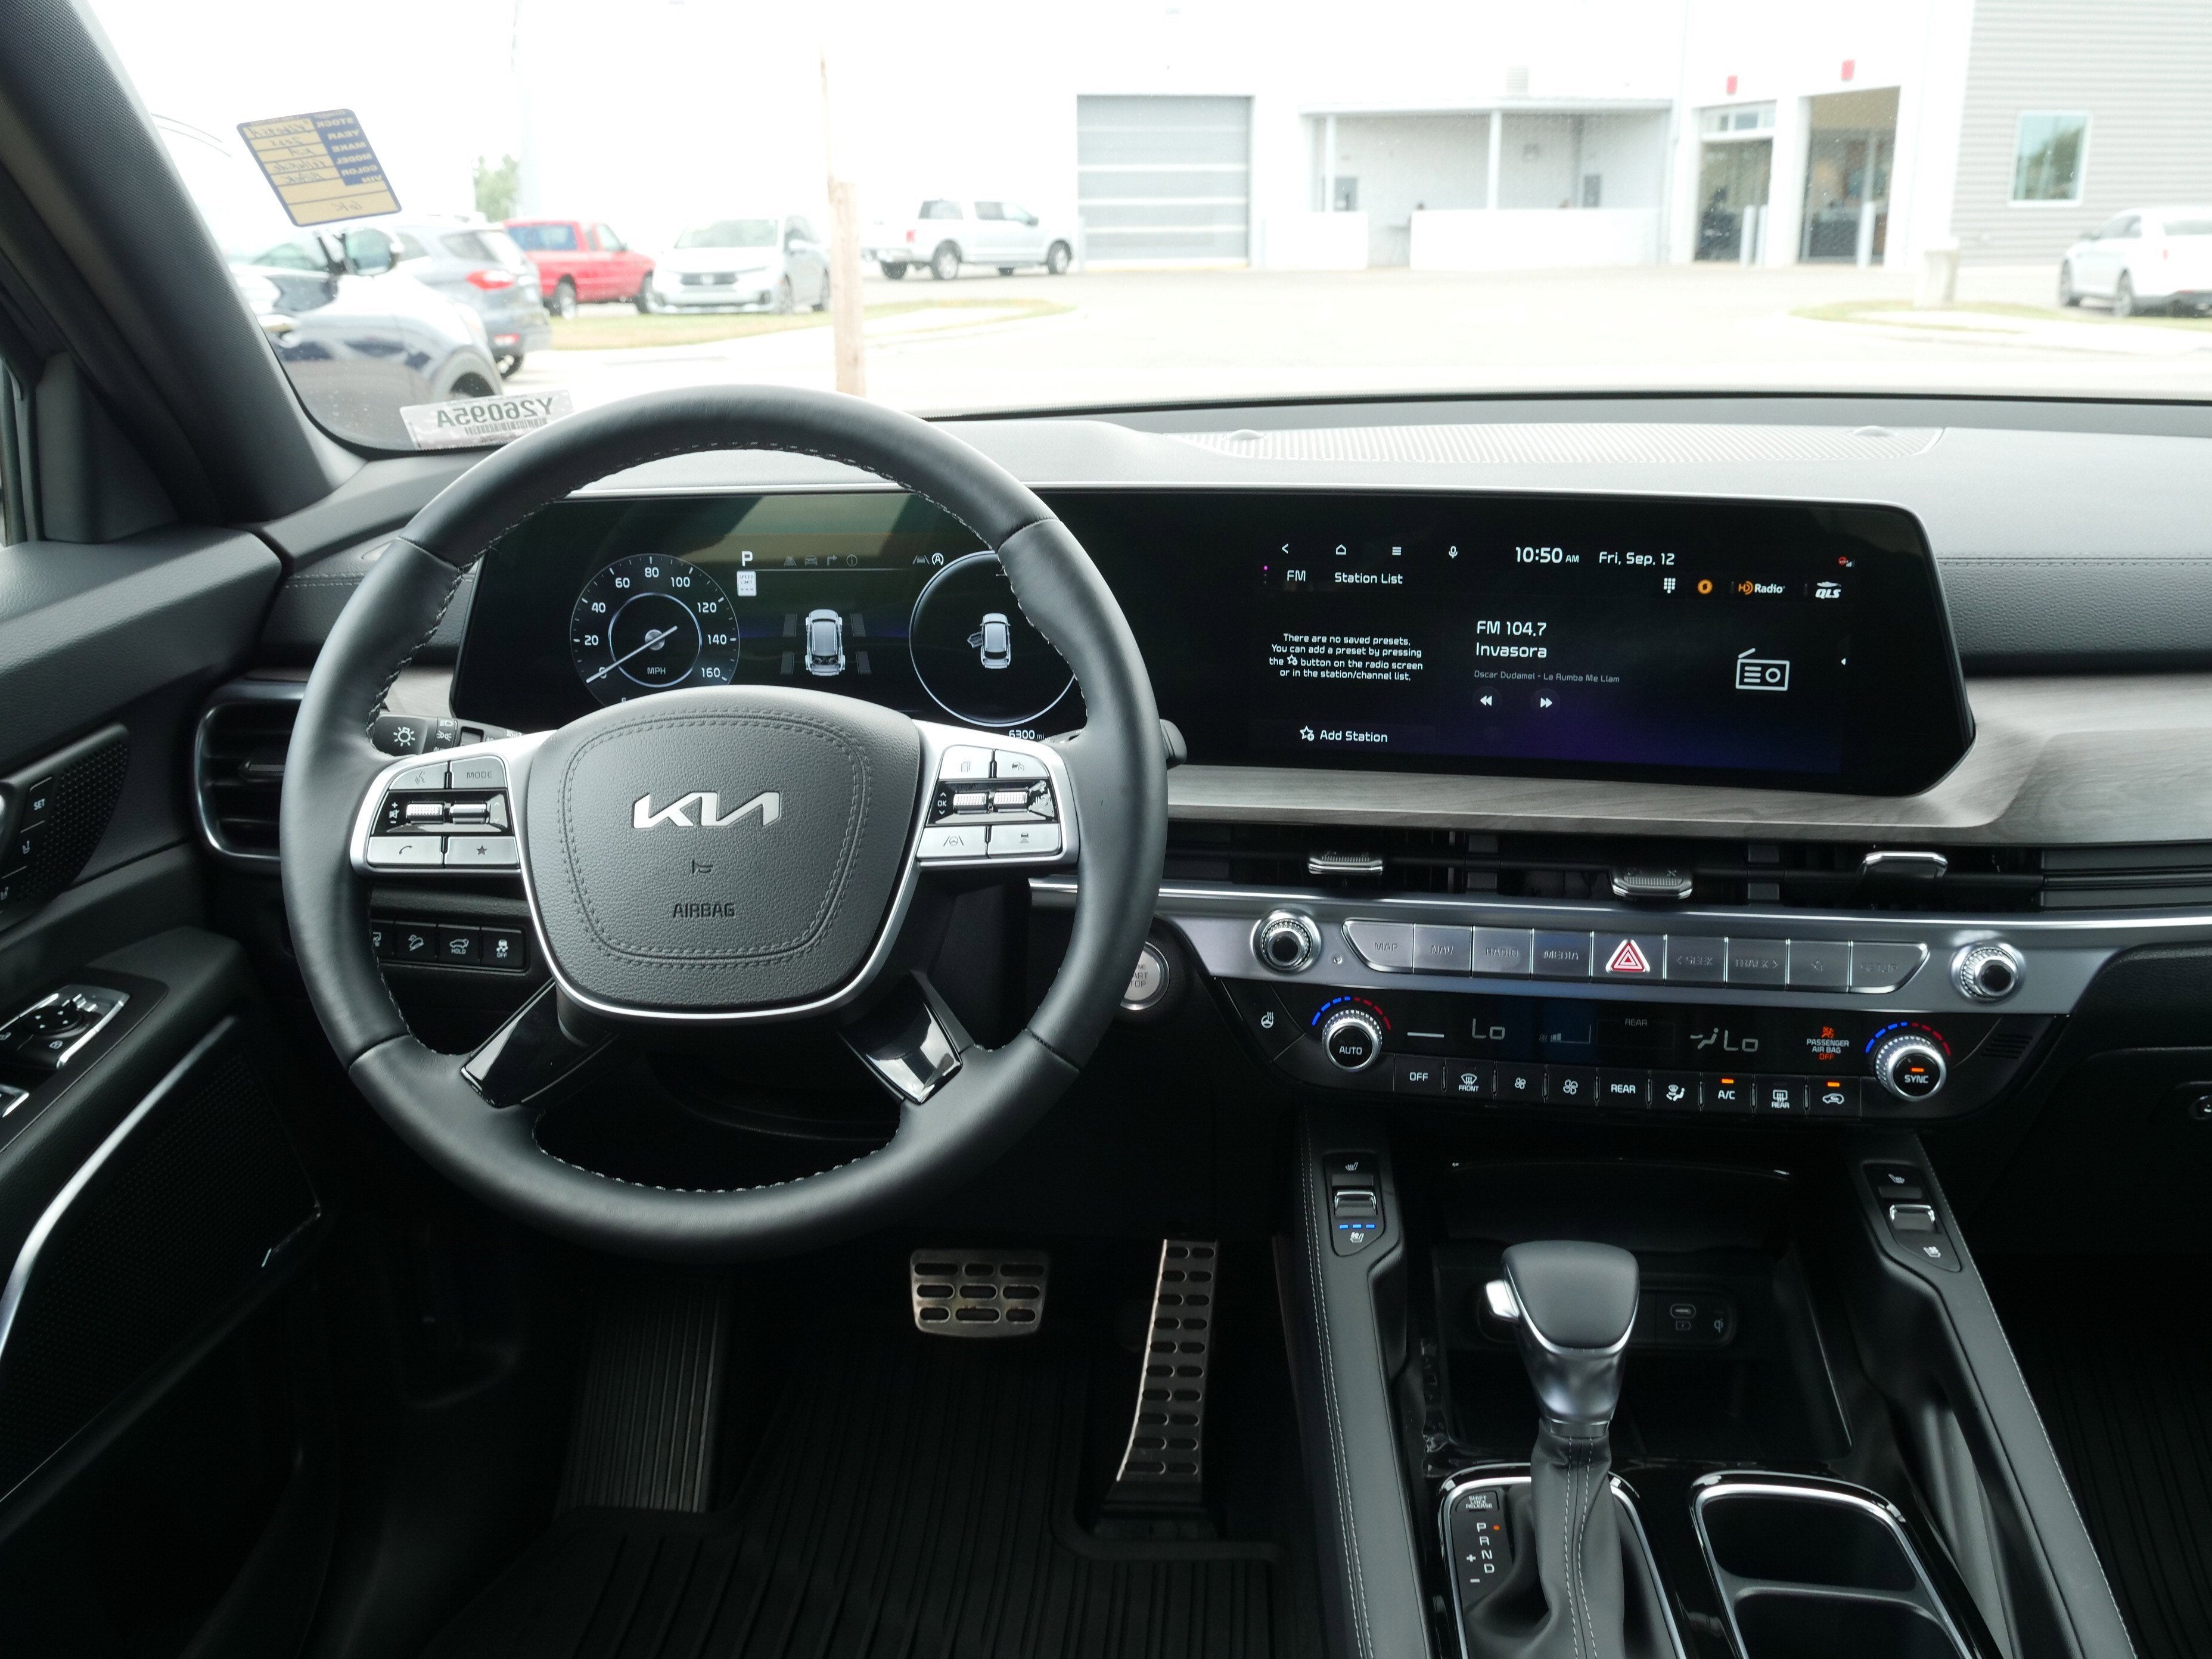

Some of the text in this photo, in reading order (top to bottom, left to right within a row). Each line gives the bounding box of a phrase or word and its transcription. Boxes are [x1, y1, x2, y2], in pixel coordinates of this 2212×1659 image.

[741, 551, 753, 567] P
[1515, 546, 1675, 567] 10:50 AM Fri, Sep. 12
[644, 567, 660, 578] 80
[1287, 570, 1403, 585] FM Station List
[615, 577, 630, 588] 60
[670, 576, 691, 588] 100
[591, 602, 606, 613] 40
[697, 602, 717, 613] 120
[1477, 620, 1547, 637] FM 104.7
[584, 635, 599, 646] 20
[707, 634, 727, 645] 140
[1283, 633, 1309, 642] There
[1343, 636, 1371, 644] saved
[1372, 637, 1411, 646] presets.
[1271, 644, 1287, 653] You
[1290, 645, 1306, 654] can
[1308, 645, 1325, 654] add
[1335, 647, 1366, 655] preset
[1368, 647, 1380, 657] by
[1382, 649, 1422, 658] pressing
[1476, 642, 1547, 658] Invasora
[1269, 657, 1284, 666] the
[1300, 658, 1331, 667] button
[1348, 659, 1363, 668] the
[1365, 660, 1389, 669] radio
[701, 667, 720, 678] 160
[1293, 669, 1301, 677] in
[1303, 669, 1318, 678] the
[1320, 670, 1393, 681] station/channel
[1394, 672, 1411, 681] list.
[1474, 670, 1498, 679] Oscar
[1500, 671, 1535, 680] Dudamel
[1555, 673, 1583, 682] Rumba
[1585, 674, 1598, 682] Me
[1008, 729, 1036, 740] 6300
[1319, 729, 1388, 742] Add Station
[33, 797, 46, 810] SET
[937, 799, 947, 807] OK
[633, 792, 779, 828] KIA
[673, 903, 735, 918] AIRBAG
[1374, 942, 1398, 952] MAP
[1431, 945, 1454, 955] NAV
[1486, 947, 1519, 958] RADIO
[1544, 950, 1579, 961] MEDIA
[1624, 1018, 1648, 1027] REAR
[1806, 1039, 1850, 1047] PASSENGER
[1339, 1046, 1362, 1055] AUTO
[1409, 1071, 1428, 1082] OFF
[1904, 1074, 1929, 1084] SYNC
[1458, 1084, 1480, 1092] FRONT
[1611, 1083, 1636, 1093] REAR
[1717, 1090, 1735, 1100] A/C
[1477, 1523, 1487, 1532] P
[1480, 1536, 1490, 1546] R
[1481, 1550, 1493, 1559] N
[1484, 1564, 1495, 1574] D
